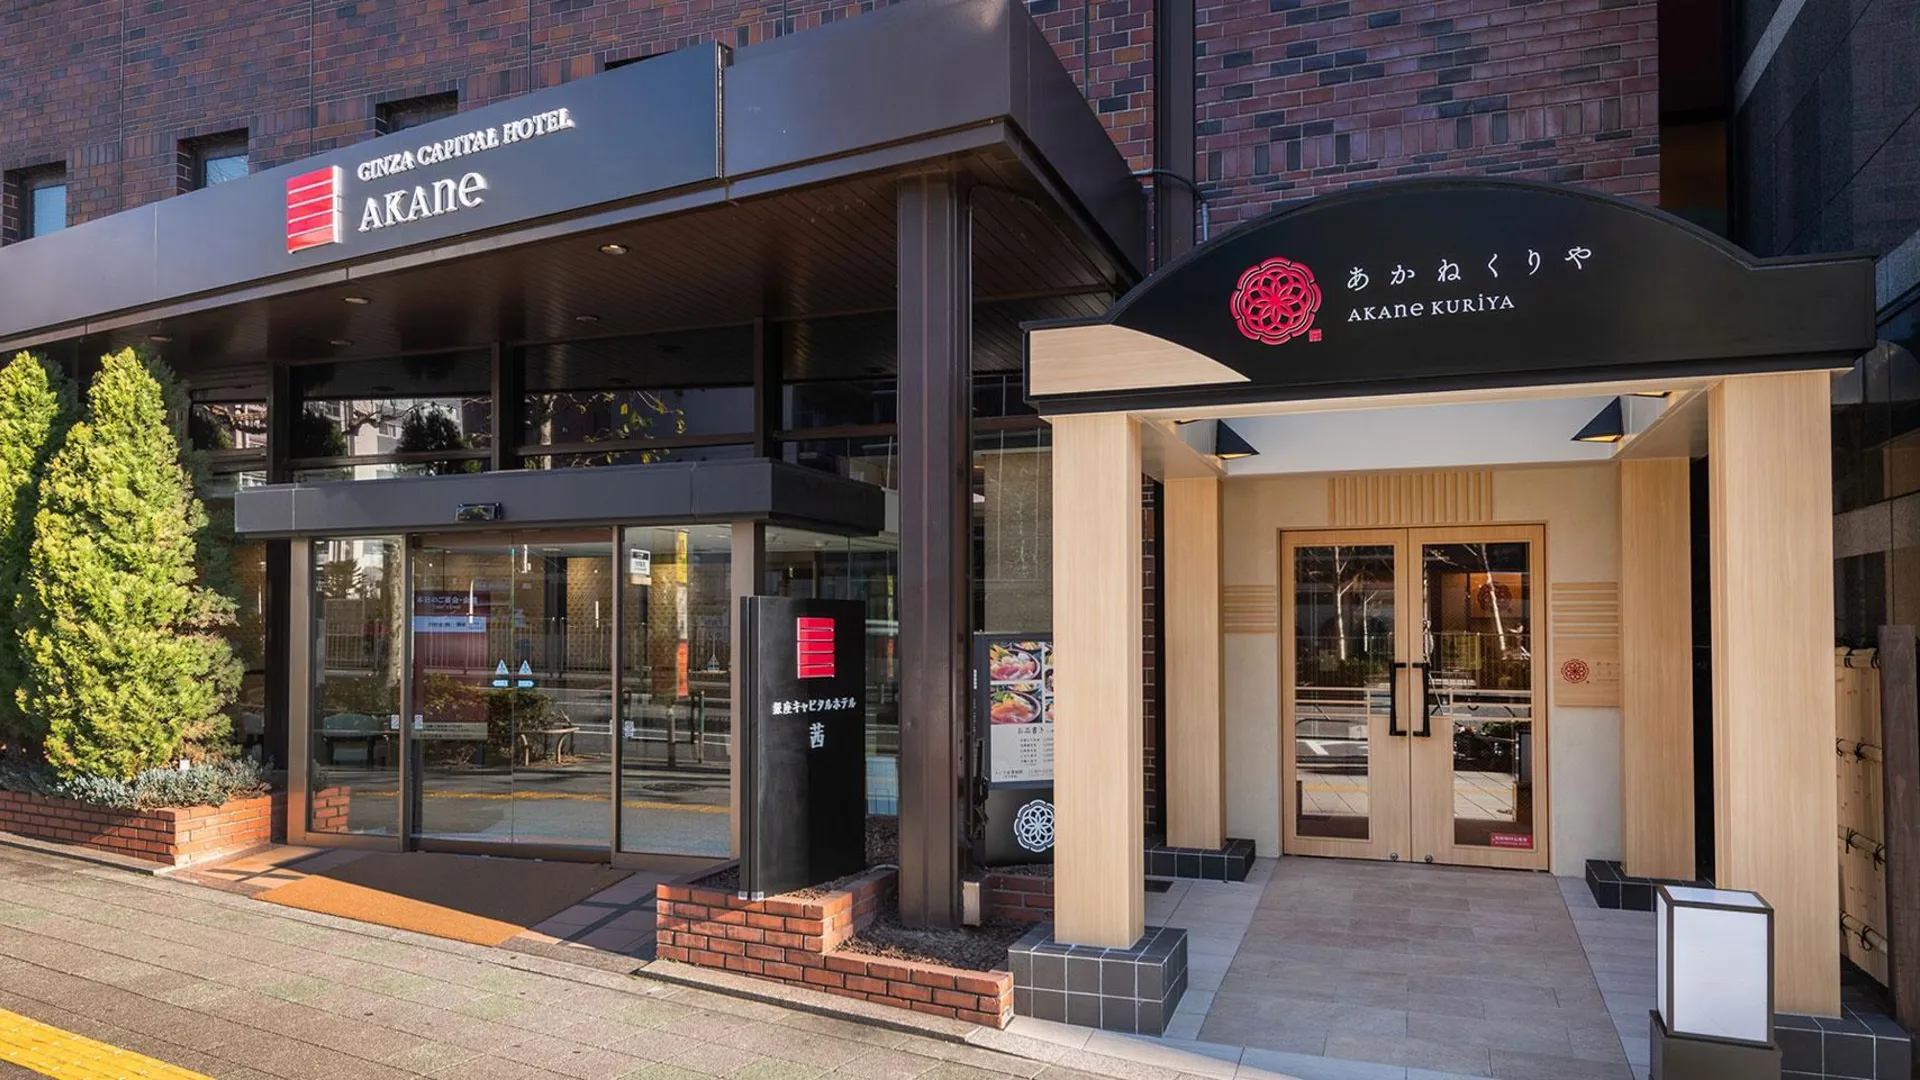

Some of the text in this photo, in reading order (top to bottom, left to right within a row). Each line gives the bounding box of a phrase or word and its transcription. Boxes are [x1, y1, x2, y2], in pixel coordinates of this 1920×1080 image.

[357, 107, 576, 182] GINZA CAPITAL HOTEL
[1346, 245, 1592, 291] あかねくりや
[772, 696, 857, 716] 銀座キャピタルホテル
[809, 722, 826, 750] 茜
